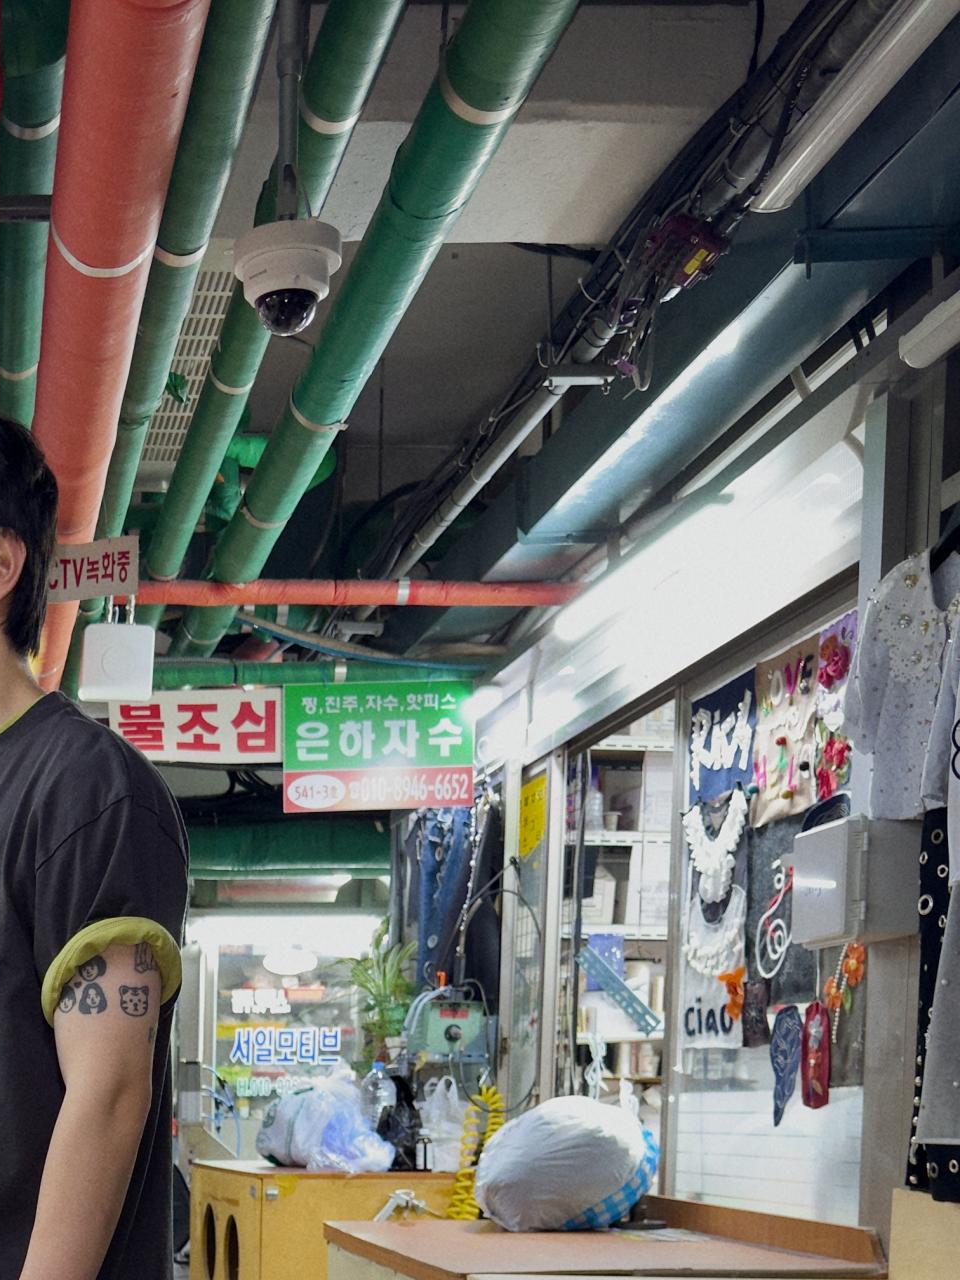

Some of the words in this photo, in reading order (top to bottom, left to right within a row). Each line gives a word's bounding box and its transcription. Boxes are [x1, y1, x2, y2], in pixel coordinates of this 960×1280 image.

[118, 699, 277, 753] 불조심
[295, 717, 464, 762] 은하자수
[231, 1028, 341, 1065] 서일모티브
